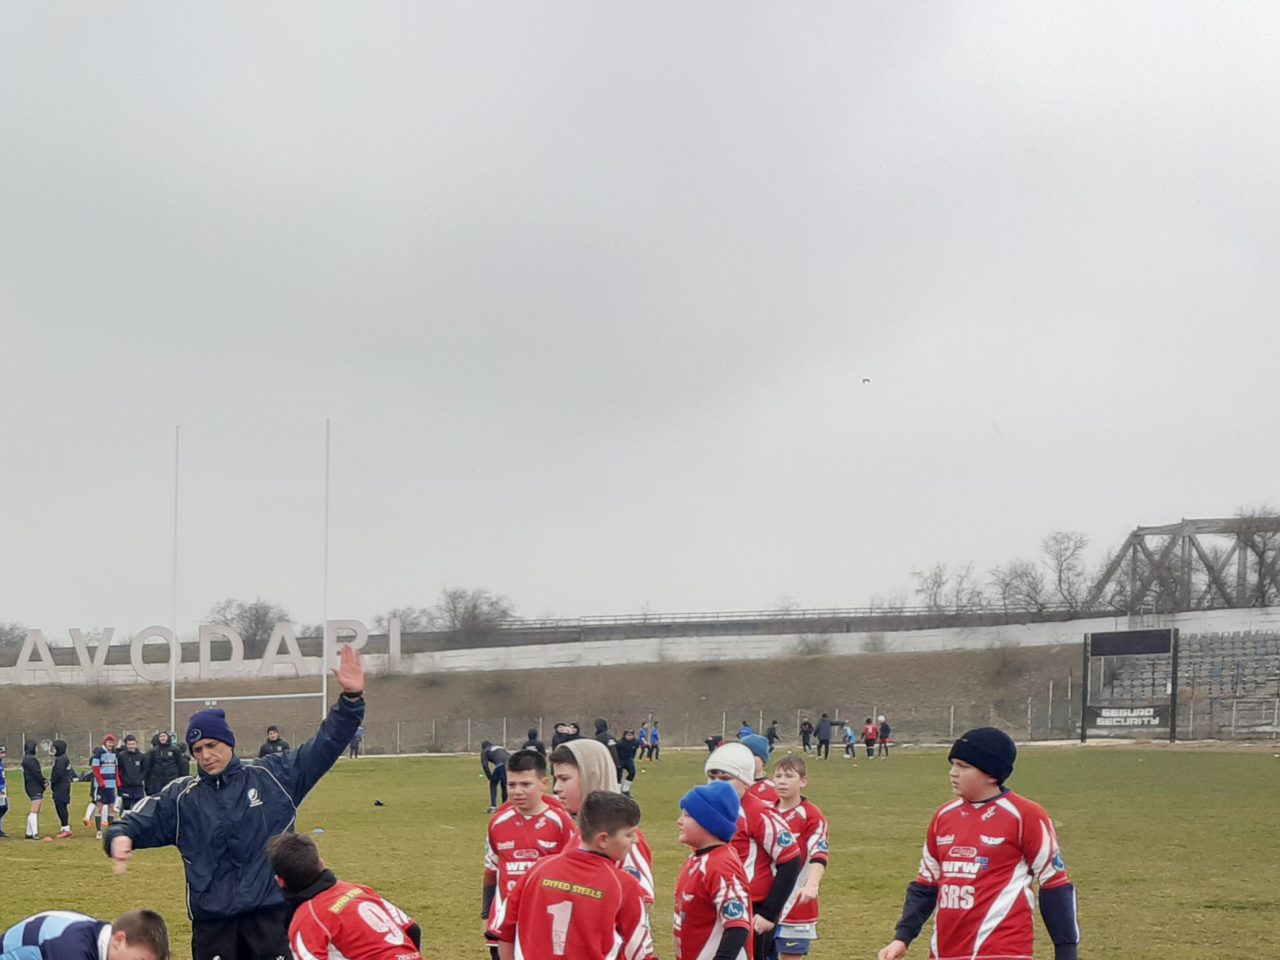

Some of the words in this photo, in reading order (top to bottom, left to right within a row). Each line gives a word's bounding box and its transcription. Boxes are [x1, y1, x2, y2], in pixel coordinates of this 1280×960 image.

[1096, 716, 1160, 726] SECURITY
[1101, 708, 1154, 717] SEGURO
[541, 879, 571, 891] DYFED
[571, 885, 603, 899] STEELS
[939, 884, 976, 910] SRS
[357, 900, 405, 946] 9
[546, 900, 573, 956] 1
